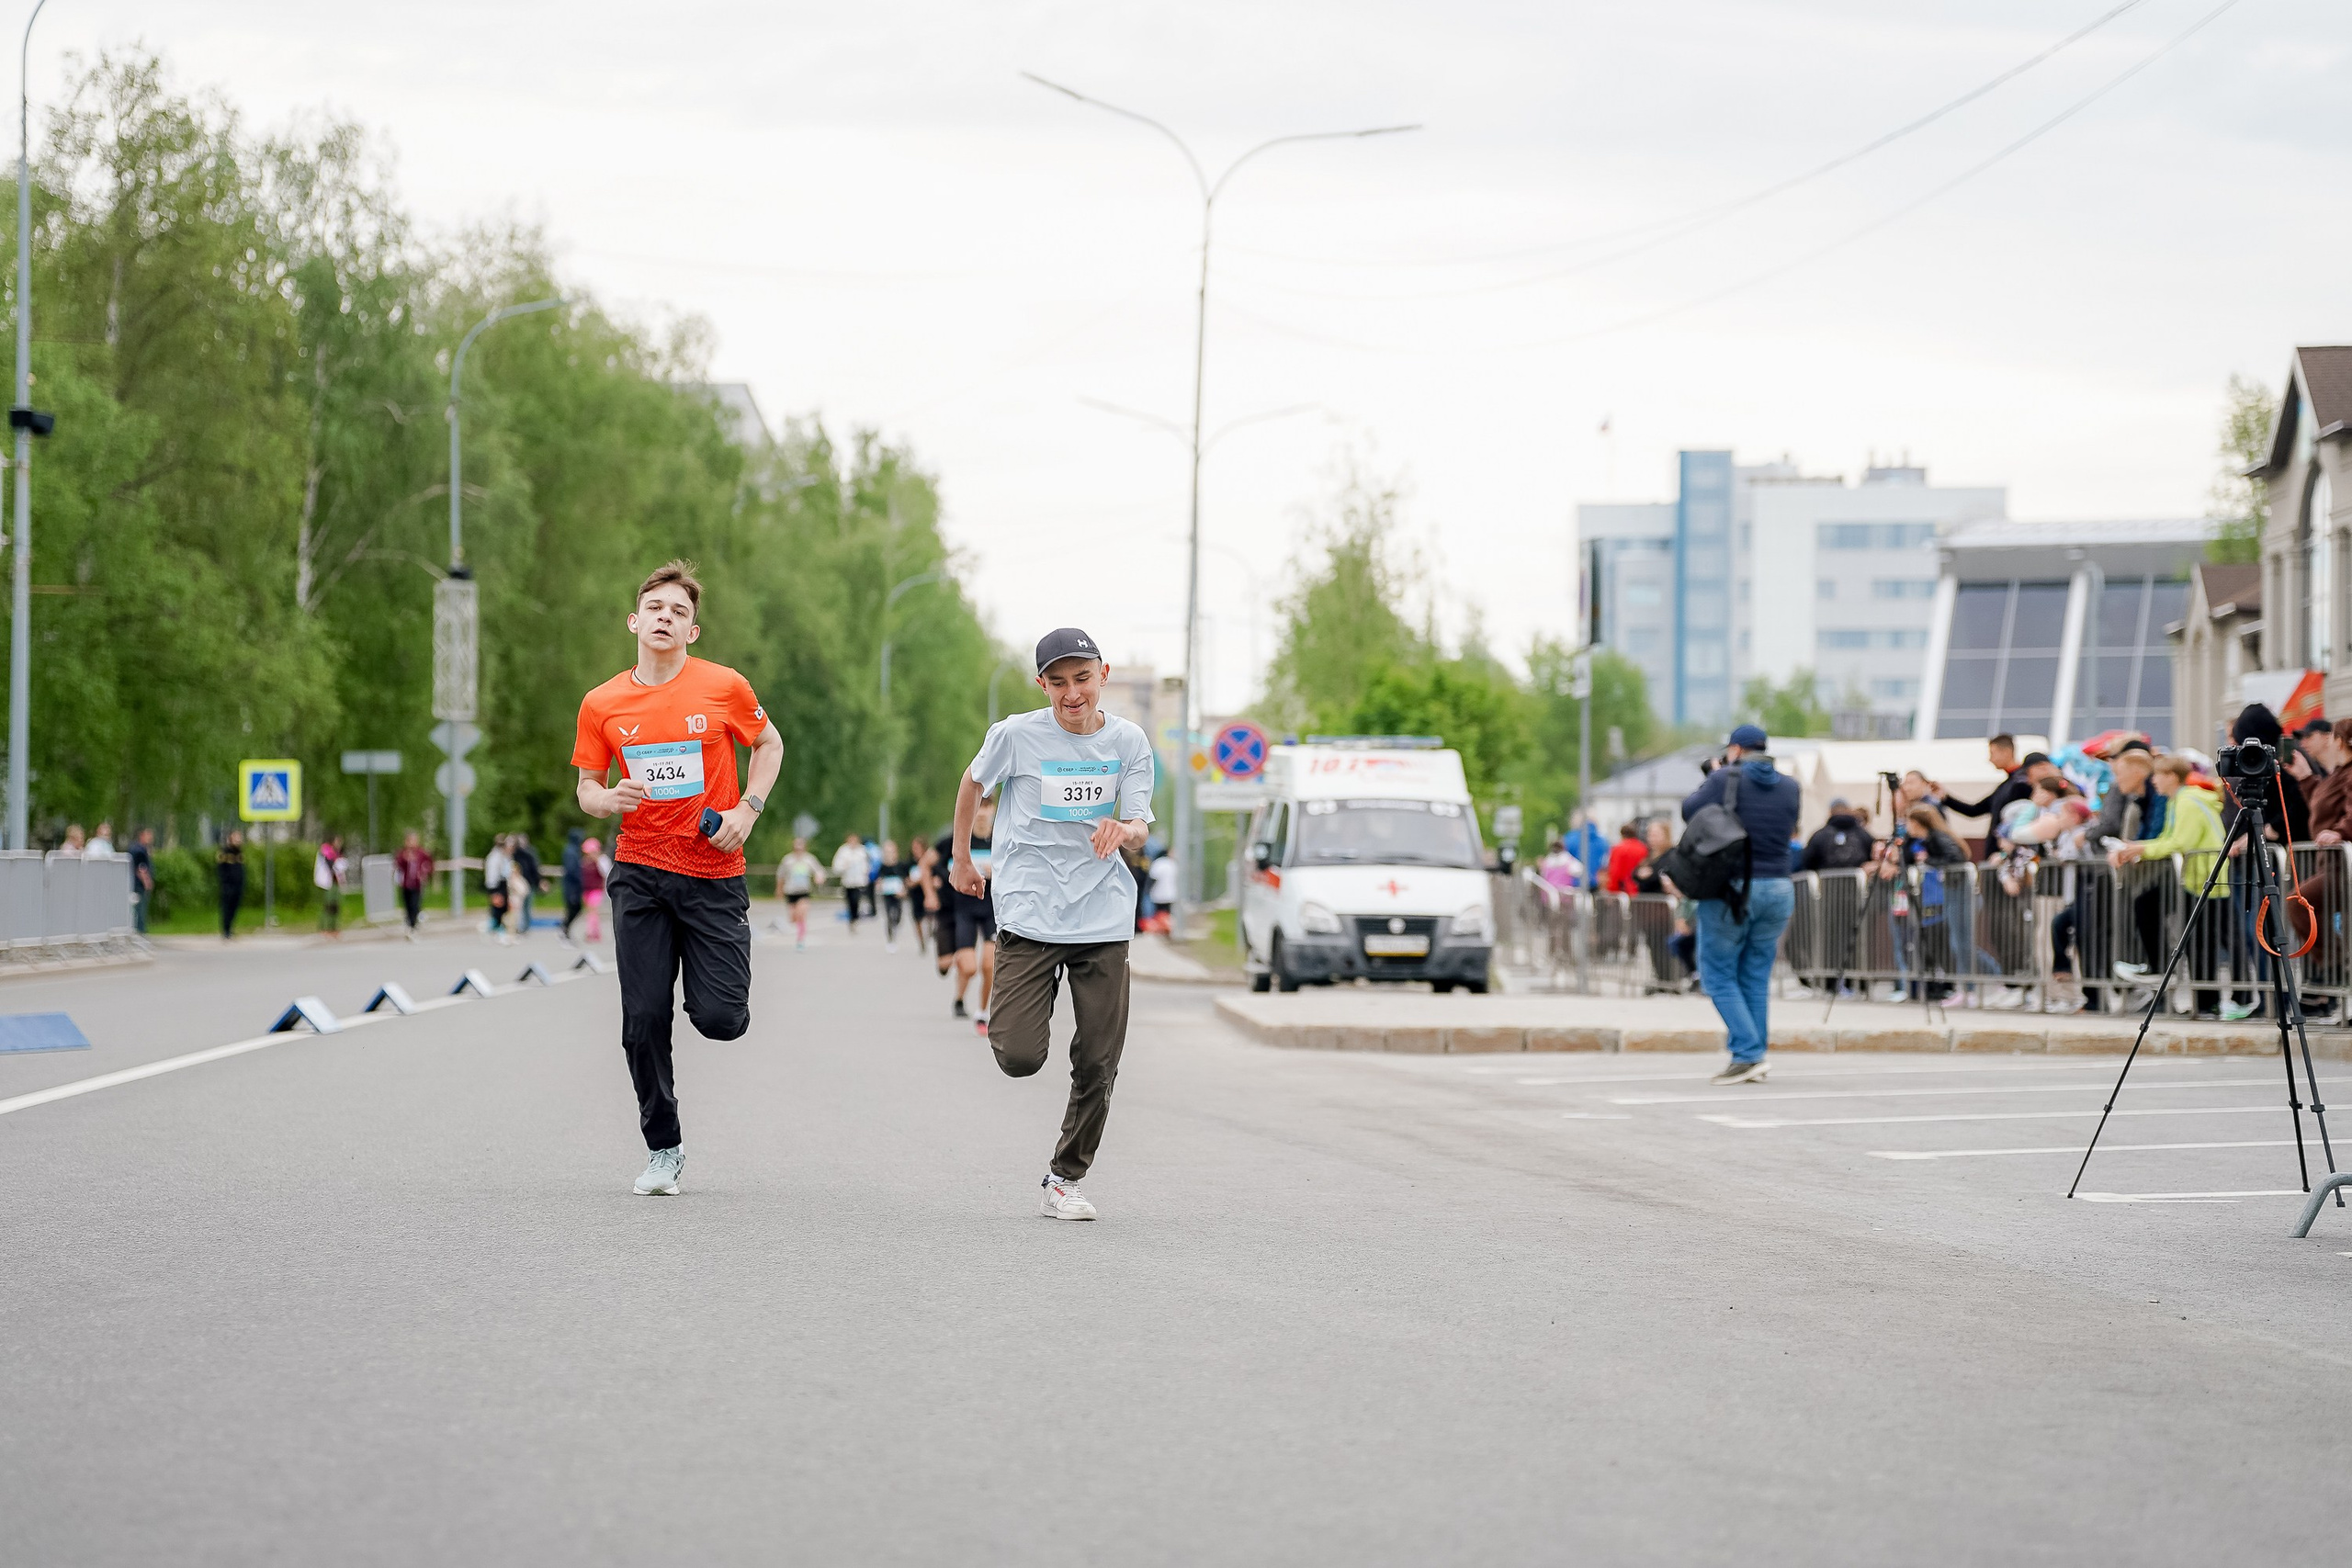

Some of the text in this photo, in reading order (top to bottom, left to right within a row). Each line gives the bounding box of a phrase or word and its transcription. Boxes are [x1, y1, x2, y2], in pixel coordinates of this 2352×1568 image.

[684, 714, 707, 734] 10
[646, 766, 685, 781] 3434
[1064, 786, 1102, 801] 3319
